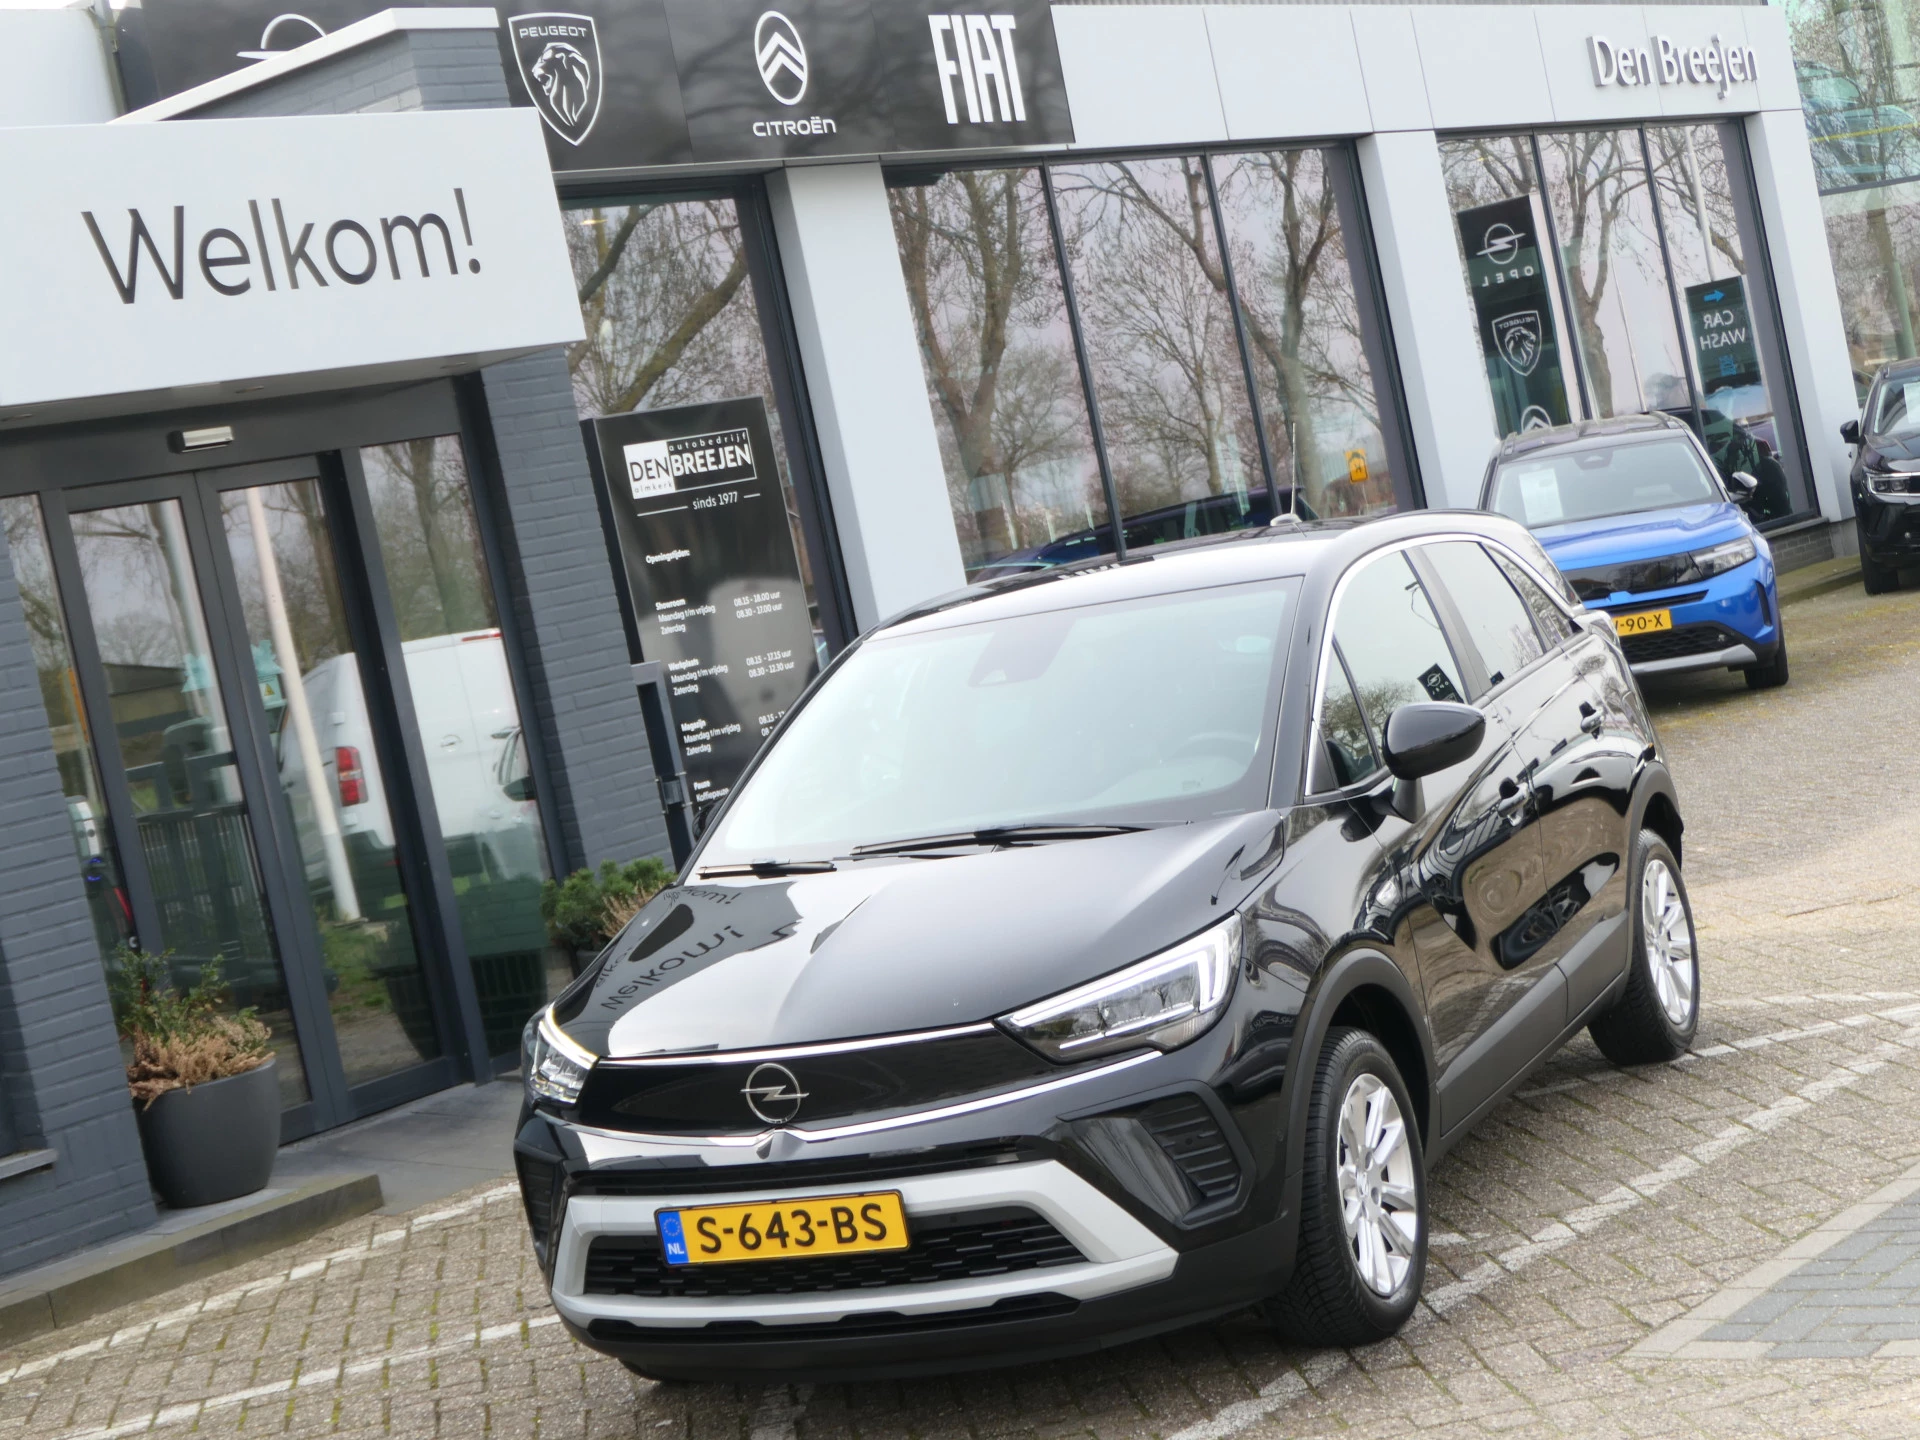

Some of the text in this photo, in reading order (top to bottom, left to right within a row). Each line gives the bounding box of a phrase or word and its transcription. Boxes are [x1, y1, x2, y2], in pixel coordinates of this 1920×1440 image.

[519, 25, 588, 39] PEUGEOT
[928, 14, 1027, 124] FIAT
[1586, 33, 1760, 100] Den Breejen
[752, 115, 837, 137] CITROËN
[81, 187, 482, 304] Welkom!
[669, 431, 747, 451] autobedrijf
[630, 443, 752, 482] DEN BREEJEN
[634, 481, 673, 494] almkerk
[692, 491, 738, 510] sinds 1977
[770, 591, 780, 600] uur
[655, 598, 686, 611] Showroom
[772, 603, 782, 611] uur
[658, 605, 716, 622] Maandag t/m vrijdag
[660, 624, 686, 635] Zaterdag
[1615, 614, 1664, 632] -90-X
[781, 650, 791, 658] uur
[671, 665, 729, 683] Maandag t/m vrijdag
[784, 662, 795, 670] uur
[673, 684, 699, 696] Zaterdag
[683, 723, 741, 743] Maandag t/m vrijdag
[686, 744, 711, 756] Zaterdag
[696, 1203, 887, 1254] S-643-BS
[667, 1242, 685, 1256] NL
